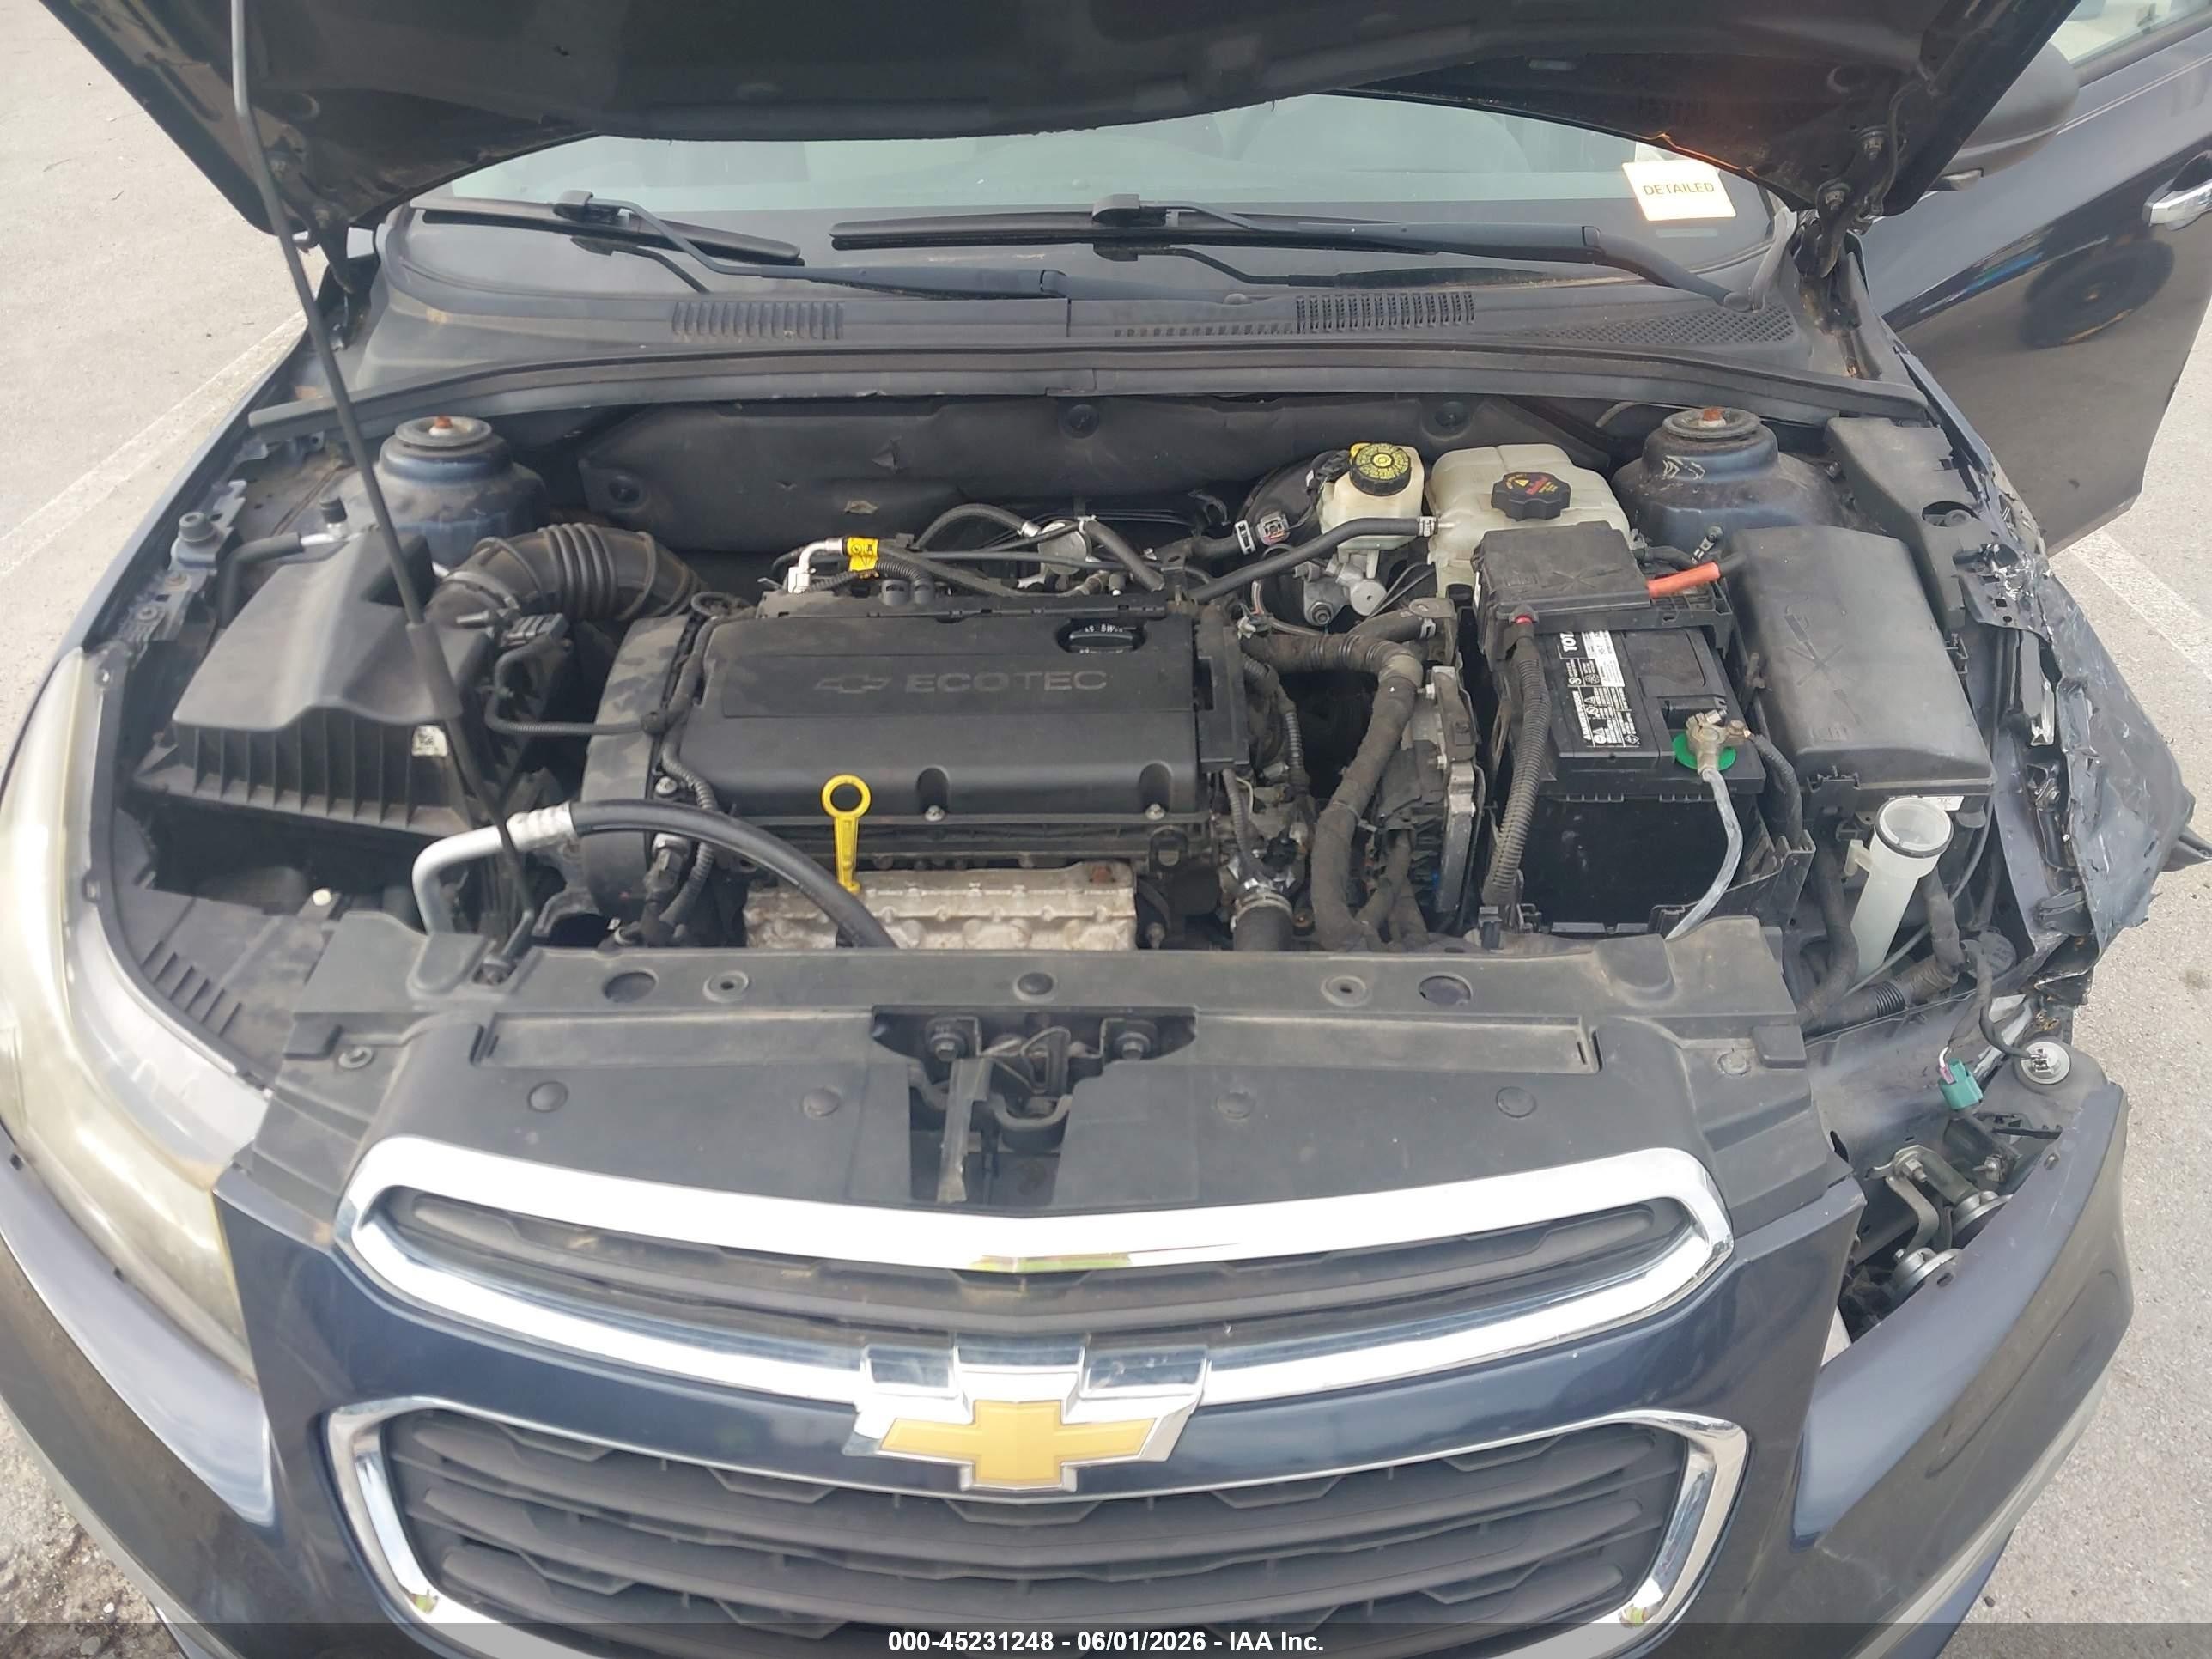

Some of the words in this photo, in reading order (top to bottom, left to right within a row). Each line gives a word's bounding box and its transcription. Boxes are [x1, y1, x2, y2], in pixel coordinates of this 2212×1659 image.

[1643, 182, 1715, 196] DETAILED
[1559, 631, 1578, 653] TOT
[907, 672, 1107, 693] ECOTEC
